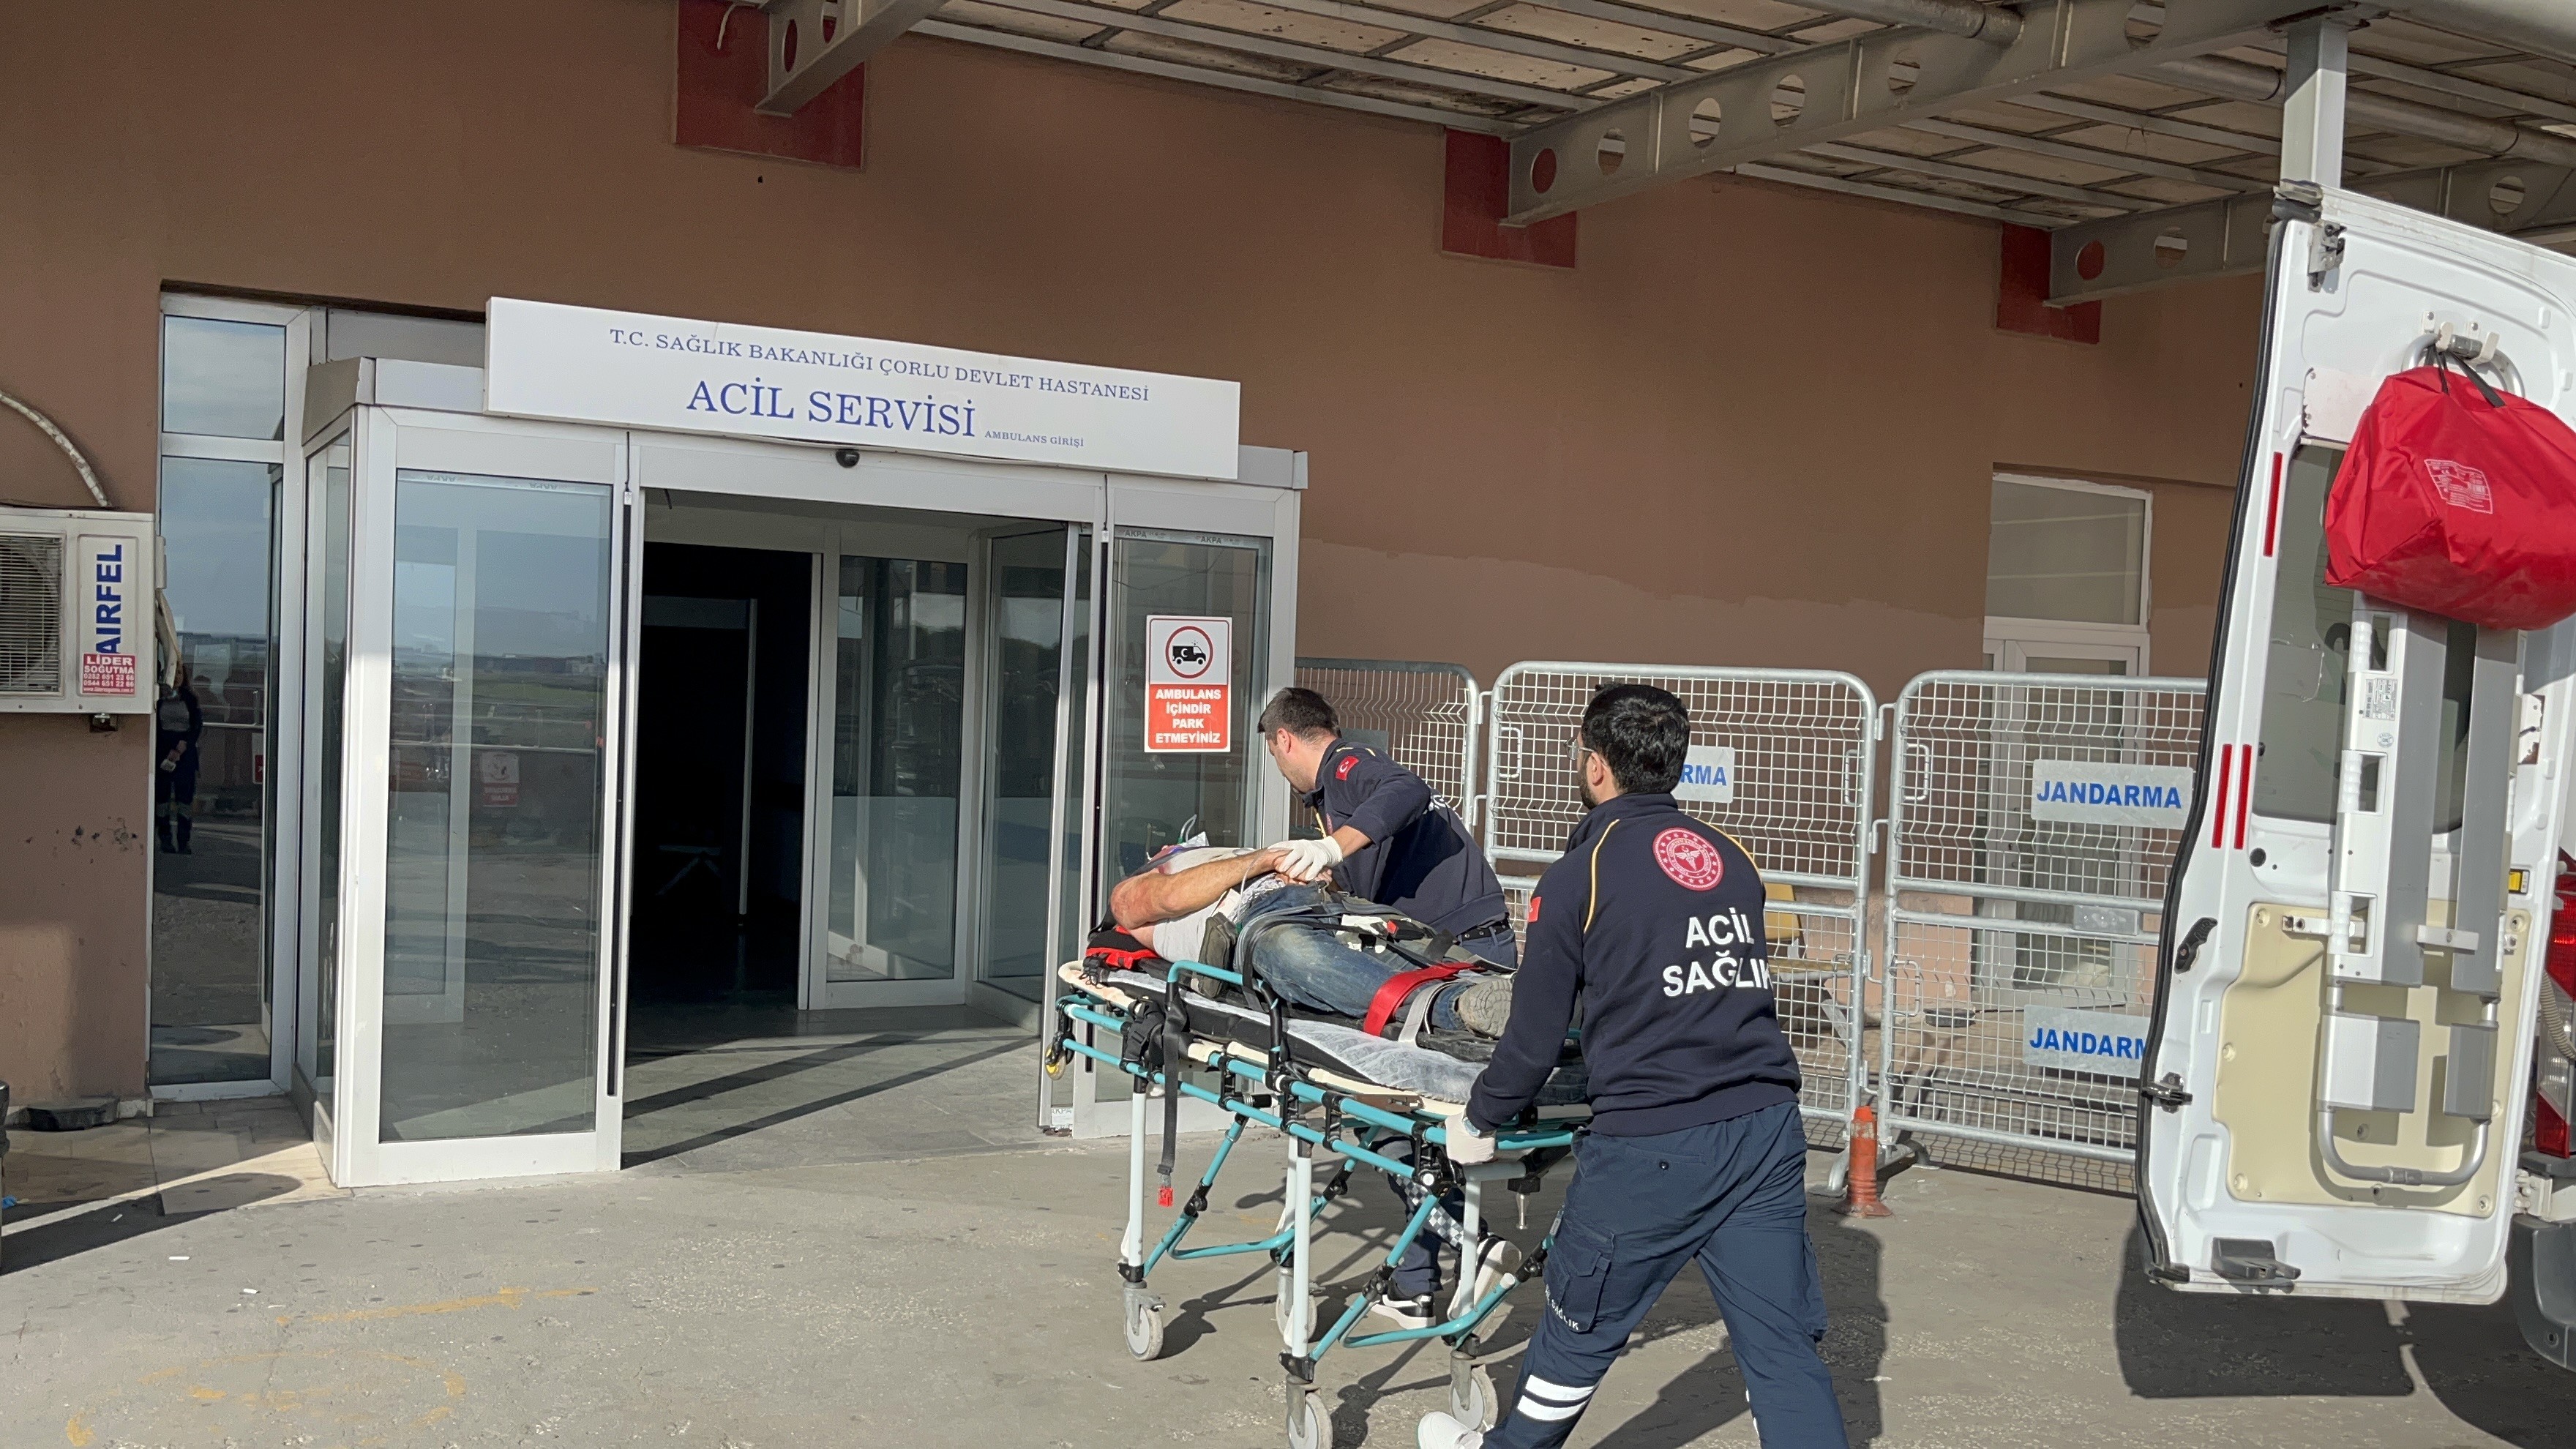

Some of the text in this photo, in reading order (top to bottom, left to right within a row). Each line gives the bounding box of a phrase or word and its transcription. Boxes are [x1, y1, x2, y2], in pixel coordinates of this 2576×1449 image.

[610, 329, 1149, 402] T.C. SAĞLIK BAKANLIĞI ÇORLU DEVLET HASTANESİ
[686, 376, 976, 438] ACİL SERVİSİ
[984, 430, 1084, 448] AMBULANS GİRİŞİ
[1124, 529, 1147, 539] AKPA
[1200, 535, 1222, 544] AKPA
[96, 544, 122, 654] AIRFEL
[86, 654, 133, 666] LİDER
[84, 664, 135, 674] SOĞUTMA
[1155, 689, 1221, 700] AMBULANS
[1166, 701, 1211, 716] İÇİNDİR
[1172, 718, 1205, 729] PARK
[1156, 730, 1221, 744] ETMEYİNİZ
[2036, 780, 2182, 809] JANDARMA
[1685, 907, 1755, 948] ACİL
[1662, 949, 1774, 997] SAĞLIK
[2029, 1027, 2146, 1060] JANDAR
